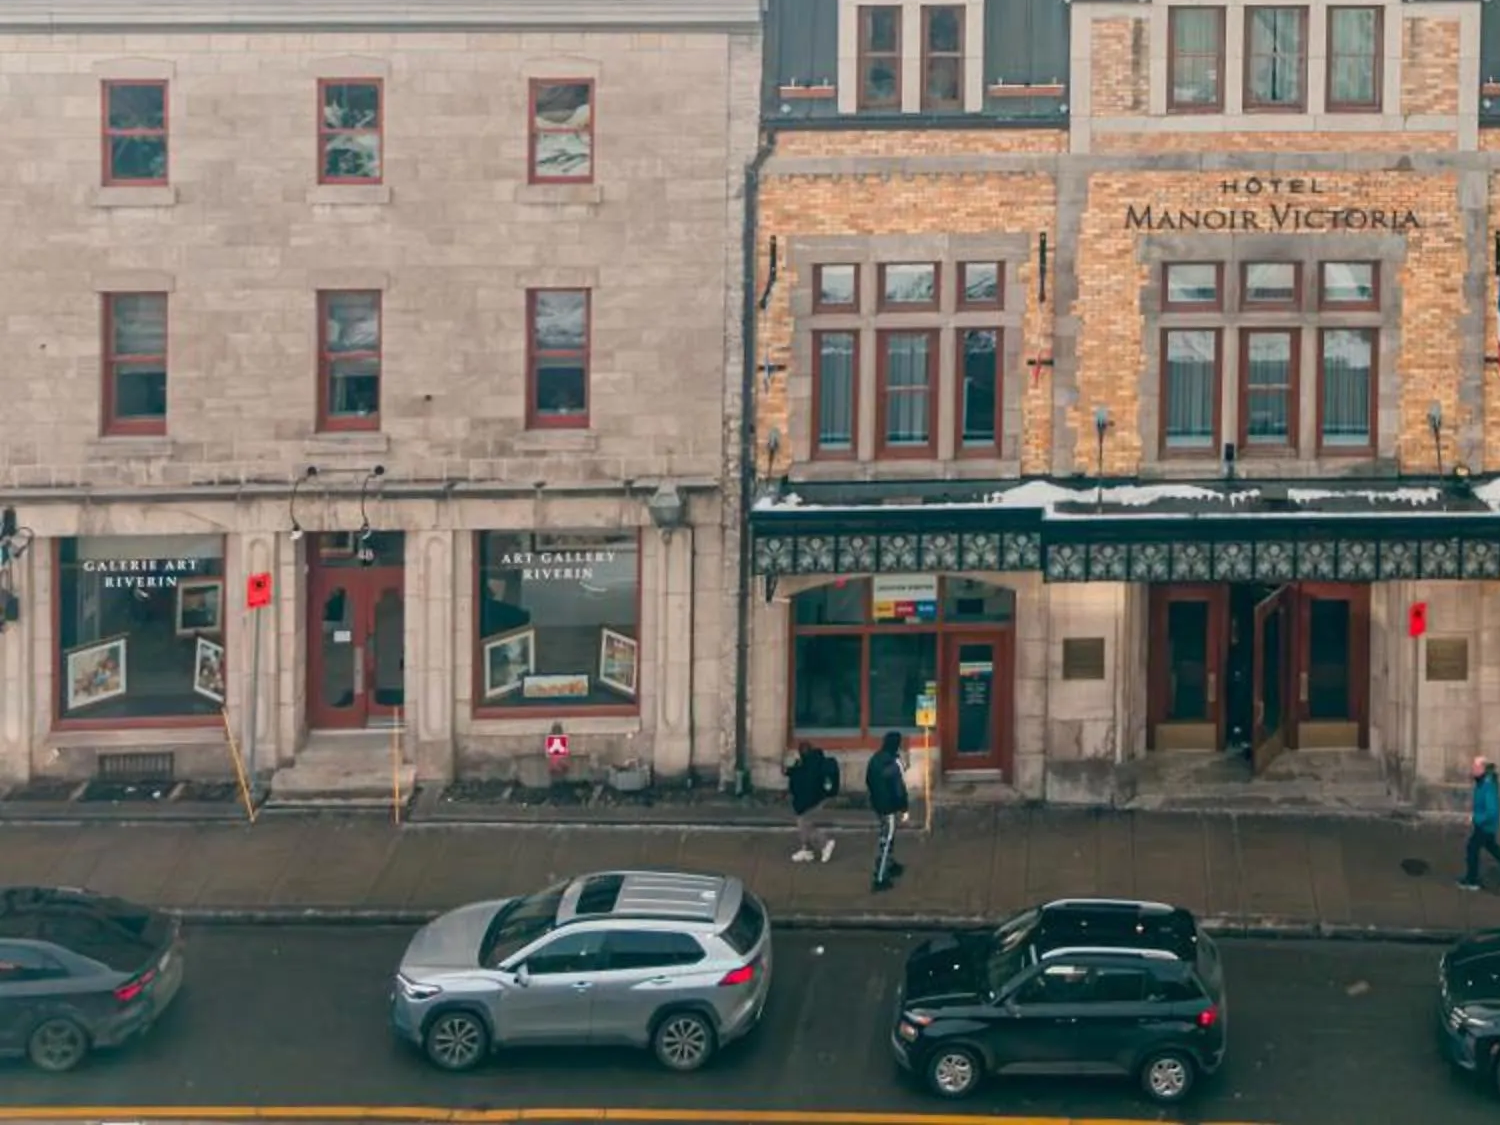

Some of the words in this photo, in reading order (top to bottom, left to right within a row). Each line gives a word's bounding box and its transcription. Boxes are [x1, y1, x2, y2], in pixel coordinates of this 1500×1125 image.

[1219, 175, 1325, 195] HÔTEL
[1124, 203, 1260, 230] MANOIR
[1269, 202, 1420, 231] VICTORIA
[82, 559, 158, 572] GALERIE
[164, 558, 198, 572] ART
[501, 553, 533, 565] ART
[540, 551, 616, 564] GALLERY
[522, 567, 594, 580] RIVERIN
[104, 575, 178, 588] RIVERIN
